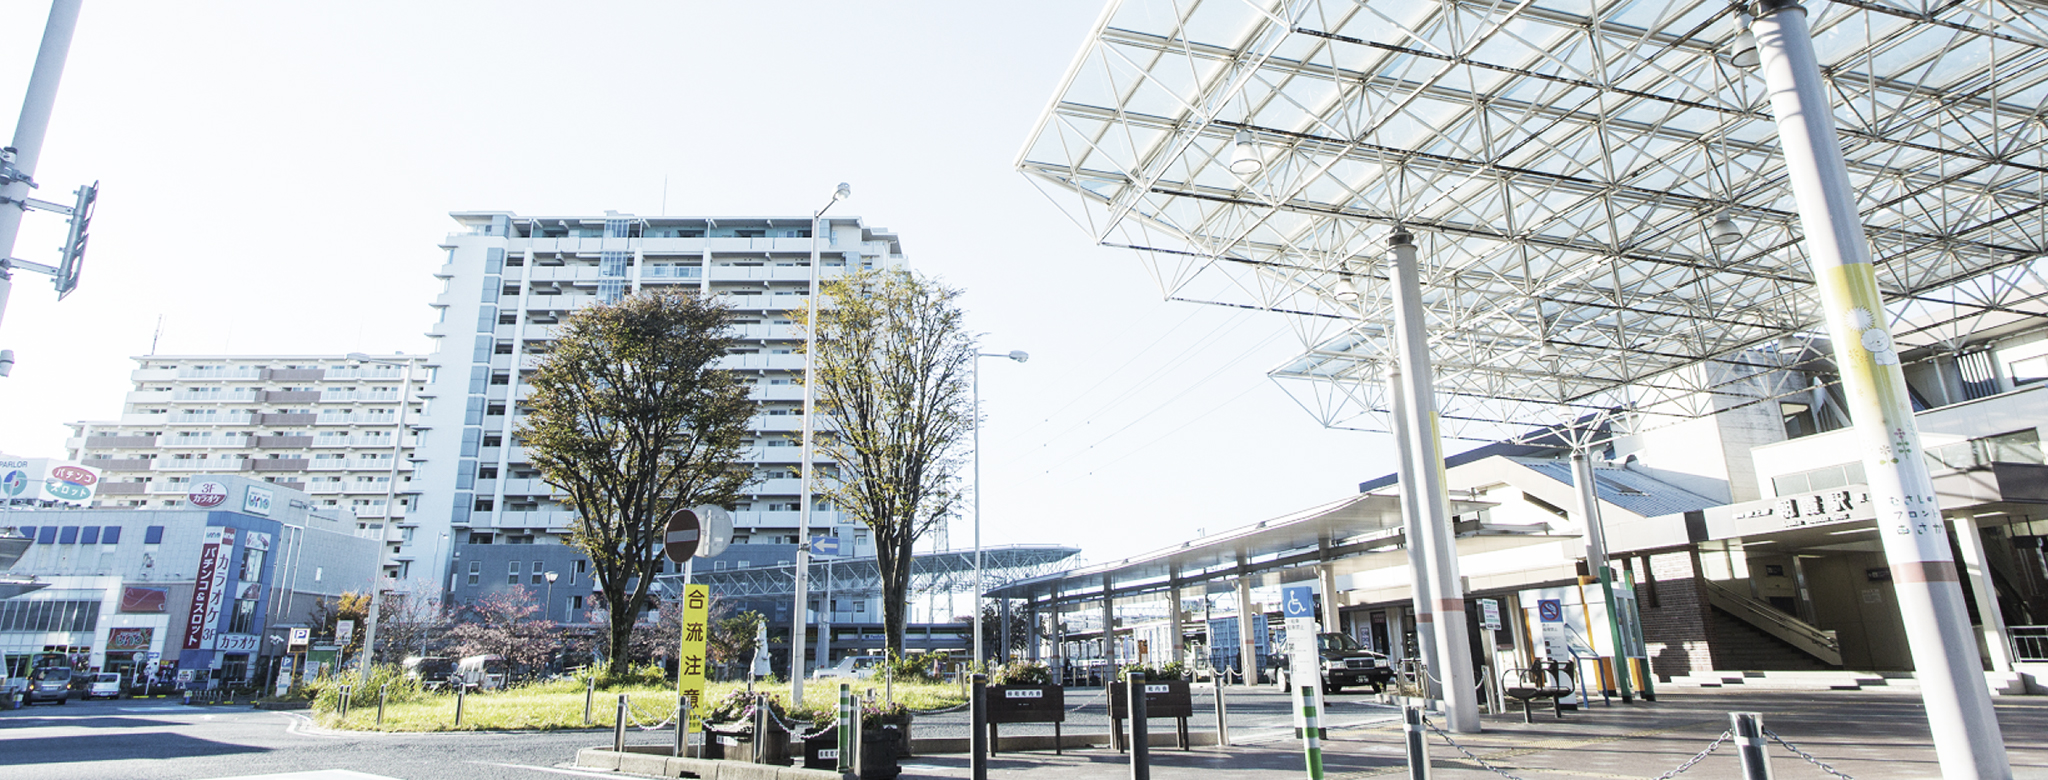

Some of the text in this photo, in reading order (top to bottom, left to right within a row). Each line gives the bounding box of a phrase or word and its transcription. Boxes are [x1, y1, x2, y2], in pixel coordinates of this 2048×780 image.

[55, 468, 93, 482] パチンコ
[50, 485, 87, 497] スロット
[202, 483, 216, 493] 3F
[193, 494, 221, 504] カラオケ
[210, 553, 229, 624] カラオケ
[188, 546, 218, 646] パチンコ&スロット
[202, 628, 216, 641] 3F
[219, 635, 257, 649] カラオケ
[683, 589, 705, 709] 合流注意
